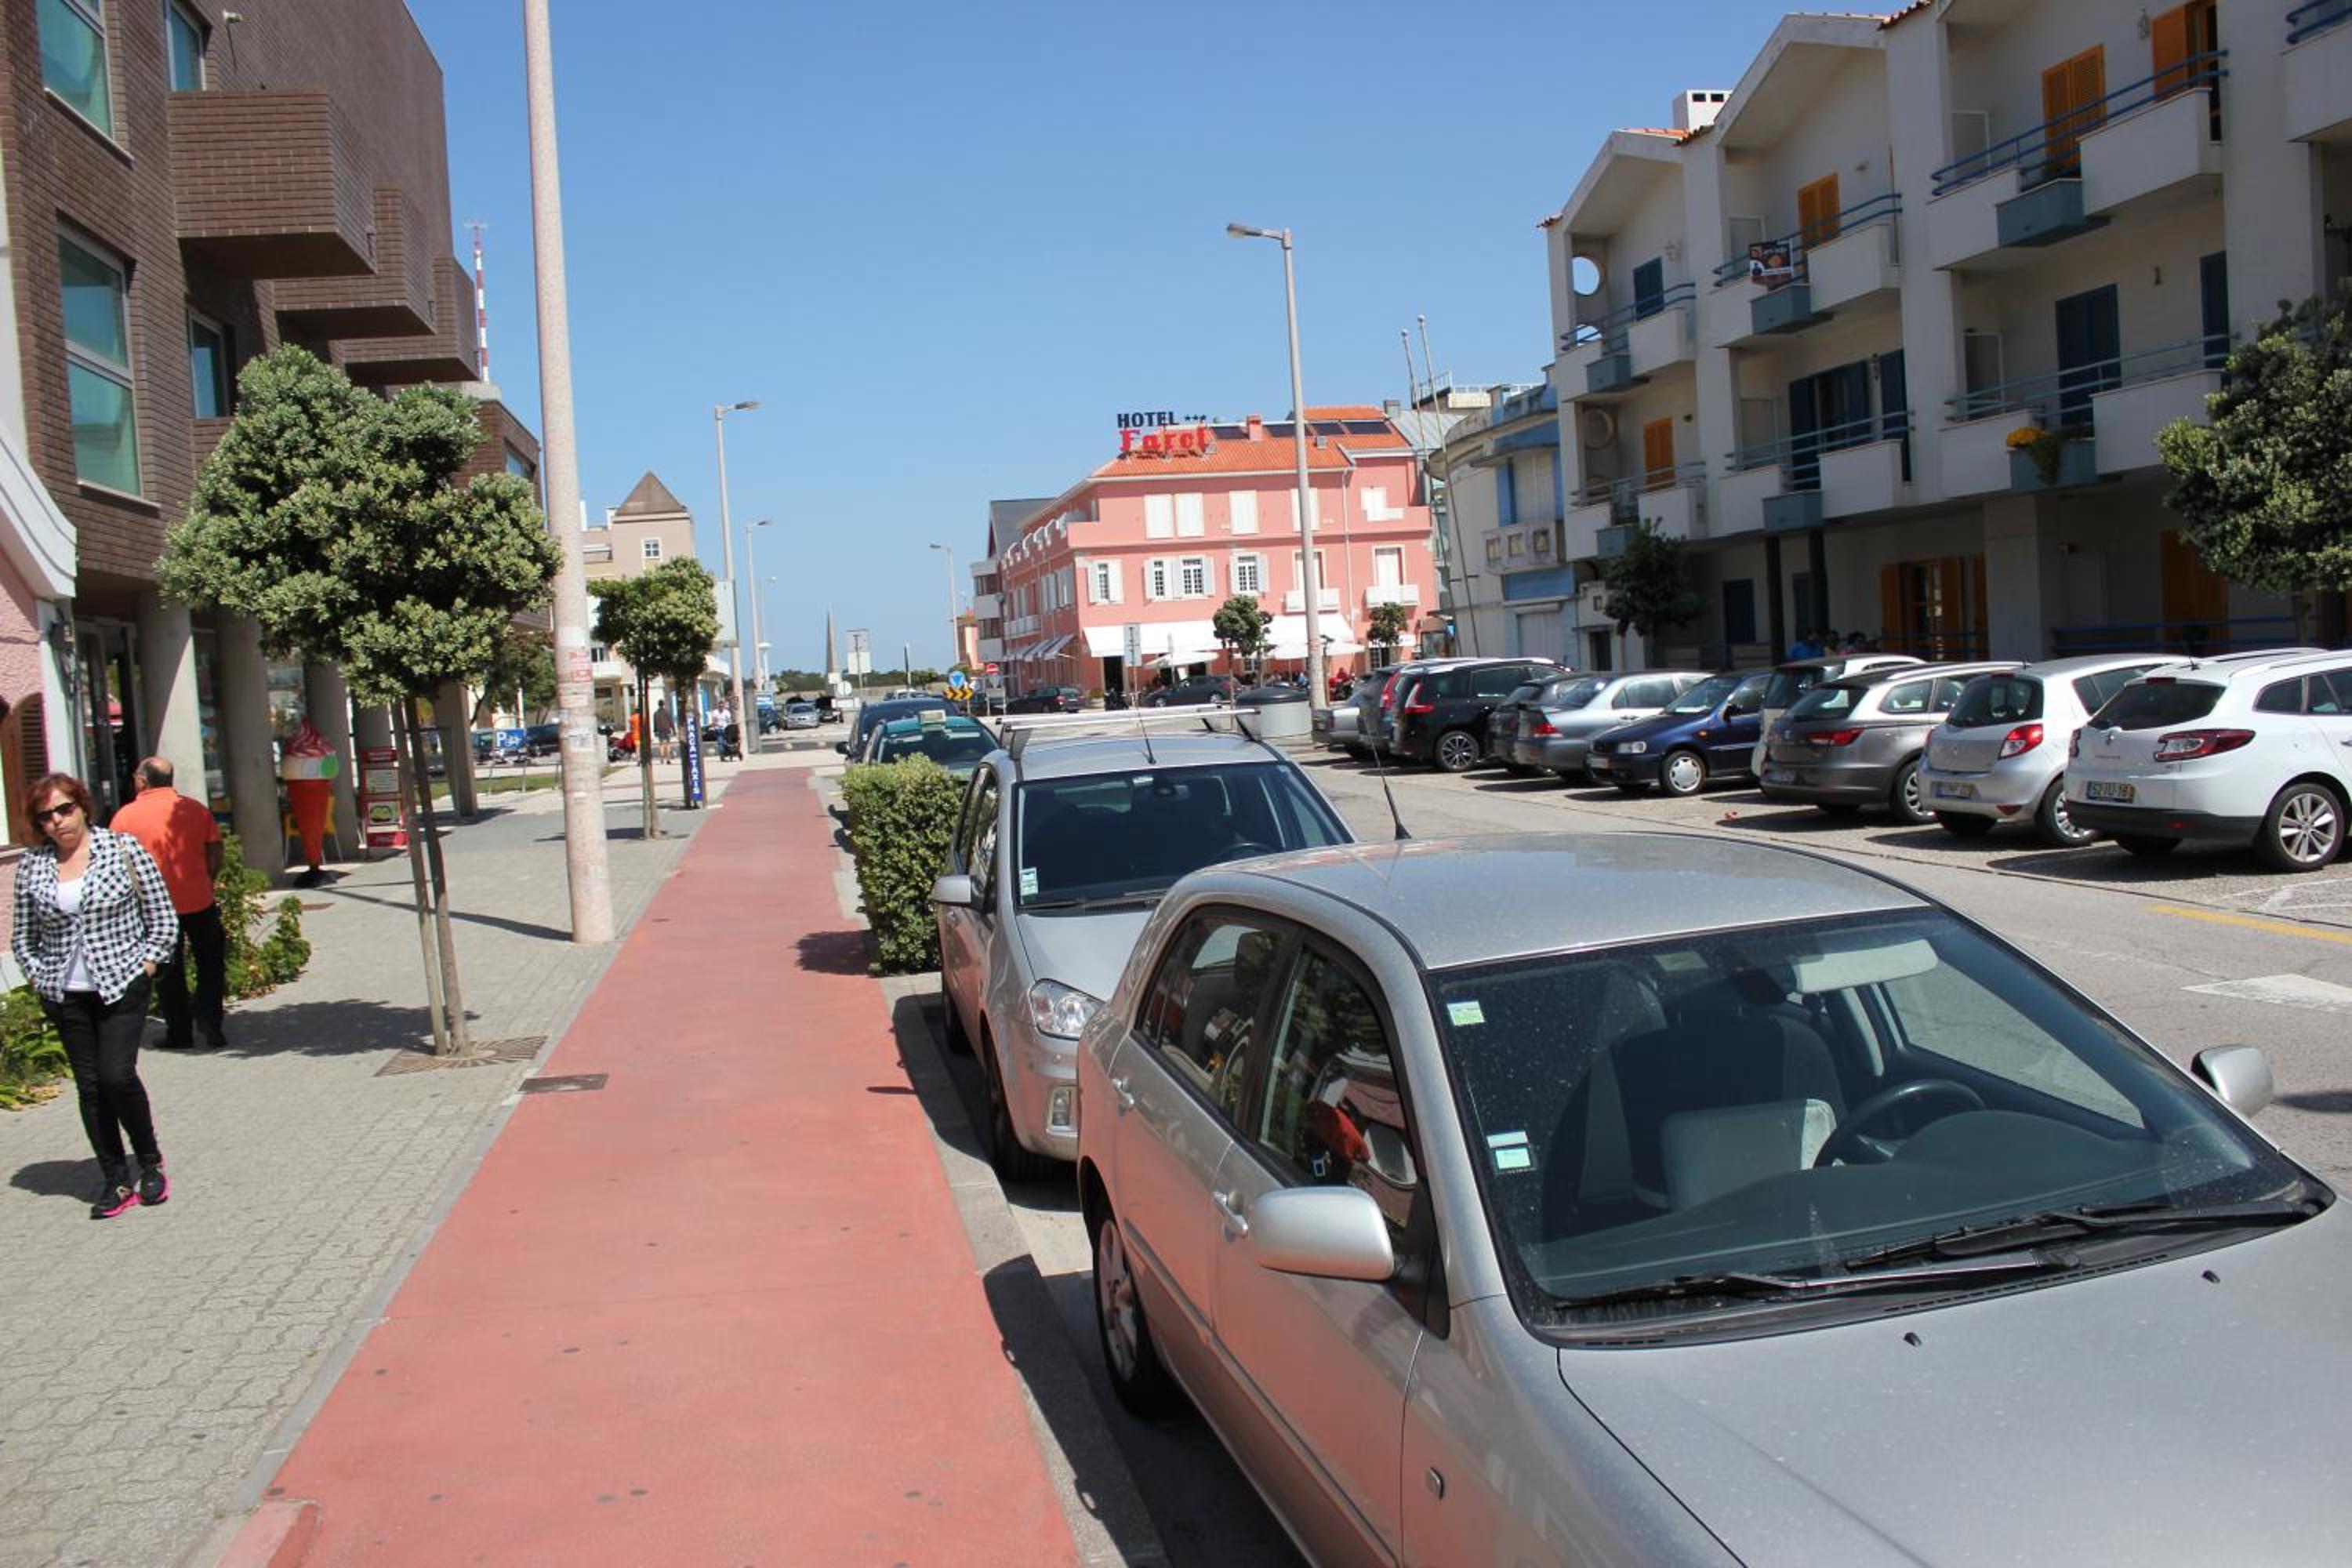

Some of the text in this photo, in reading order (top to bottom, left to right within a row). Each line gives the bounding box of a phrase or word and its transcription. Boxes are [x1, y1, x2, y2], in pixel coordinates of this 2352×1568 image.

[1116, 412, 1179, 428] HOTEL
[1120, 427, 1206, 452] Farol
[496, 731, 506, 747] P
